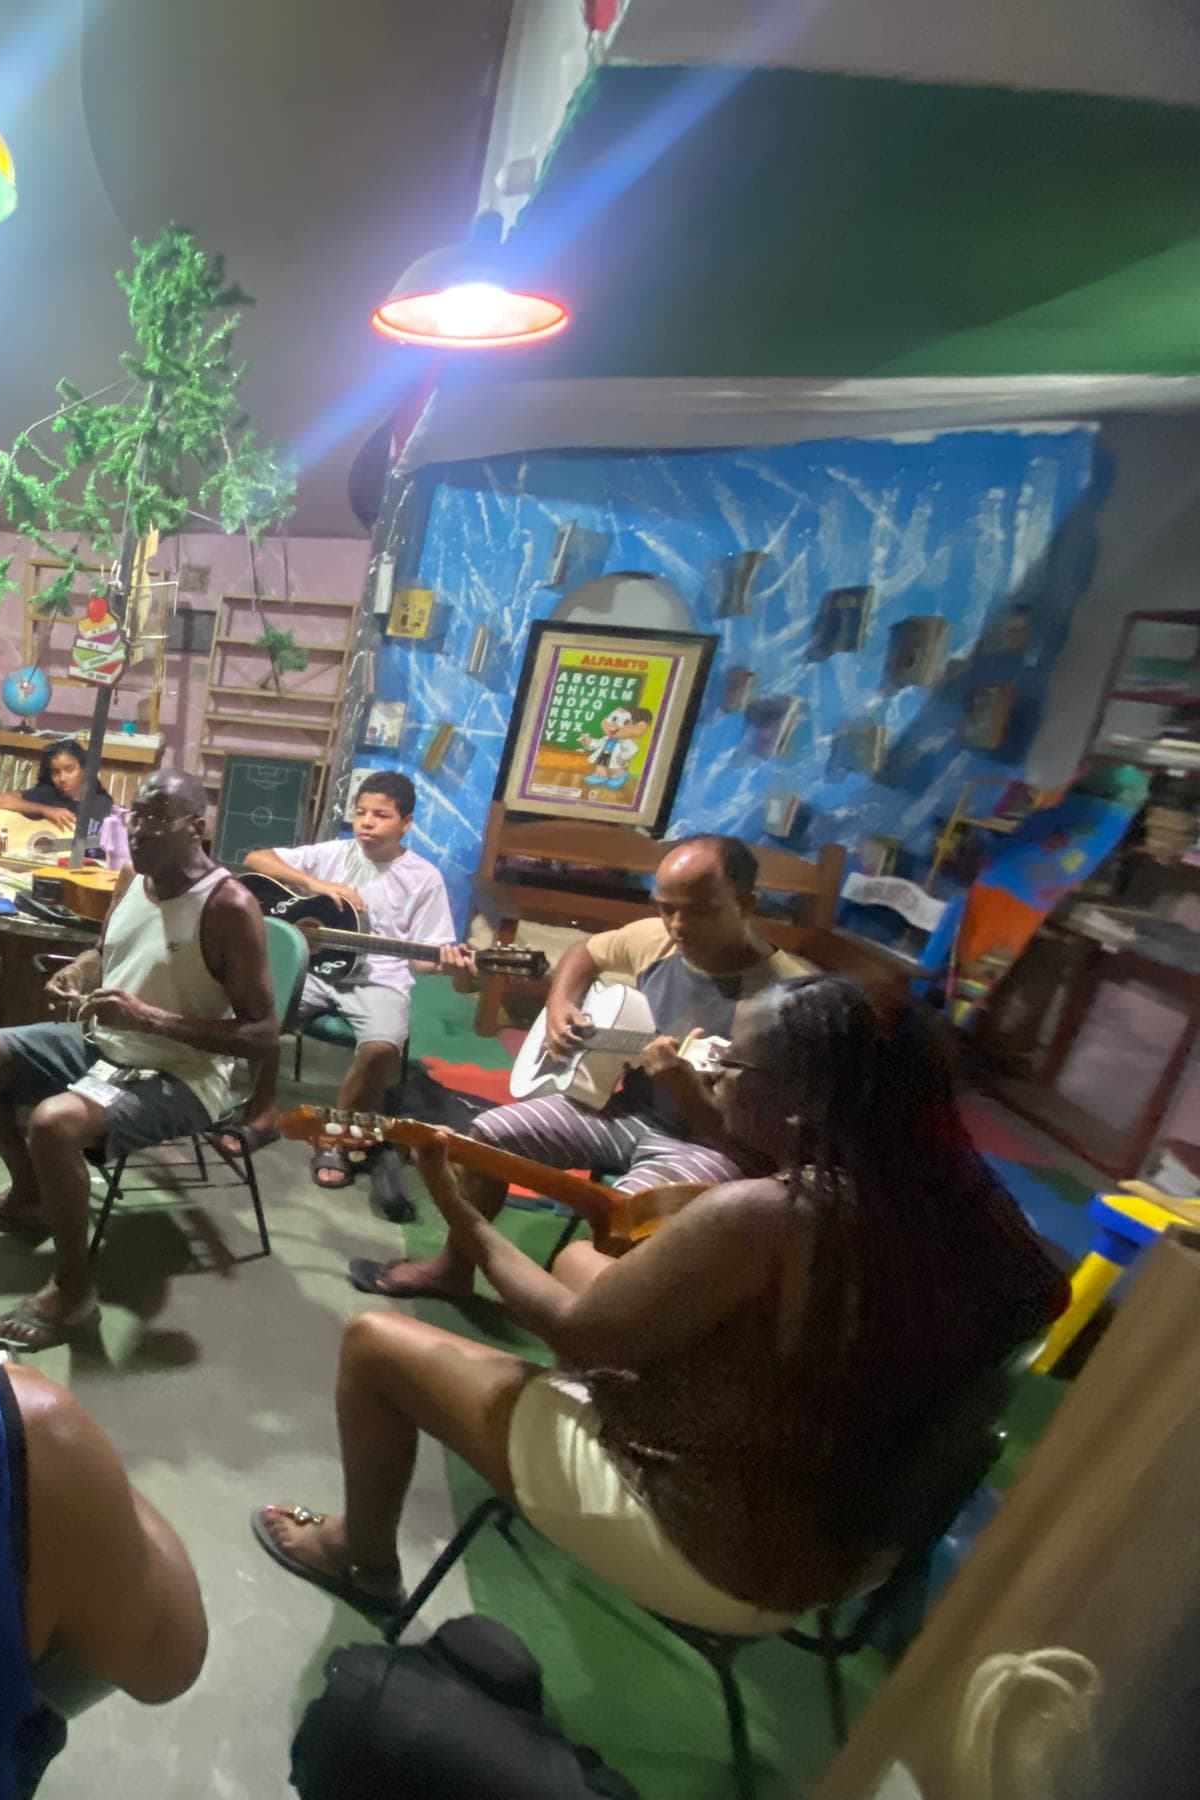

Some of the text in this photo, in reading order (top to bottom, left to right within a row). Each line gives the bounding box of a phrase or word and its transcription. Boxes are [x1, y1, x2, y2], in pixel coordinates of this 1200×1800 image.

[581, 654, 648, 670] ALFABETO
[557, 672, 637, 688] A B C D E F
[555, 684, 565, 694] G
[567, 685, 578, 695] H
[587, 687, 596, 697] J
[598, 688, 608, 699] K
[610, 689, 618, 700] L
[621, 690, 633, 701] M
[552, 696, 602, 710] N O P Q
[549, 707, 595, 721] R S T U
[547, 719, 584, 732] V W X
[545, 730, 568, 742] Y Z
